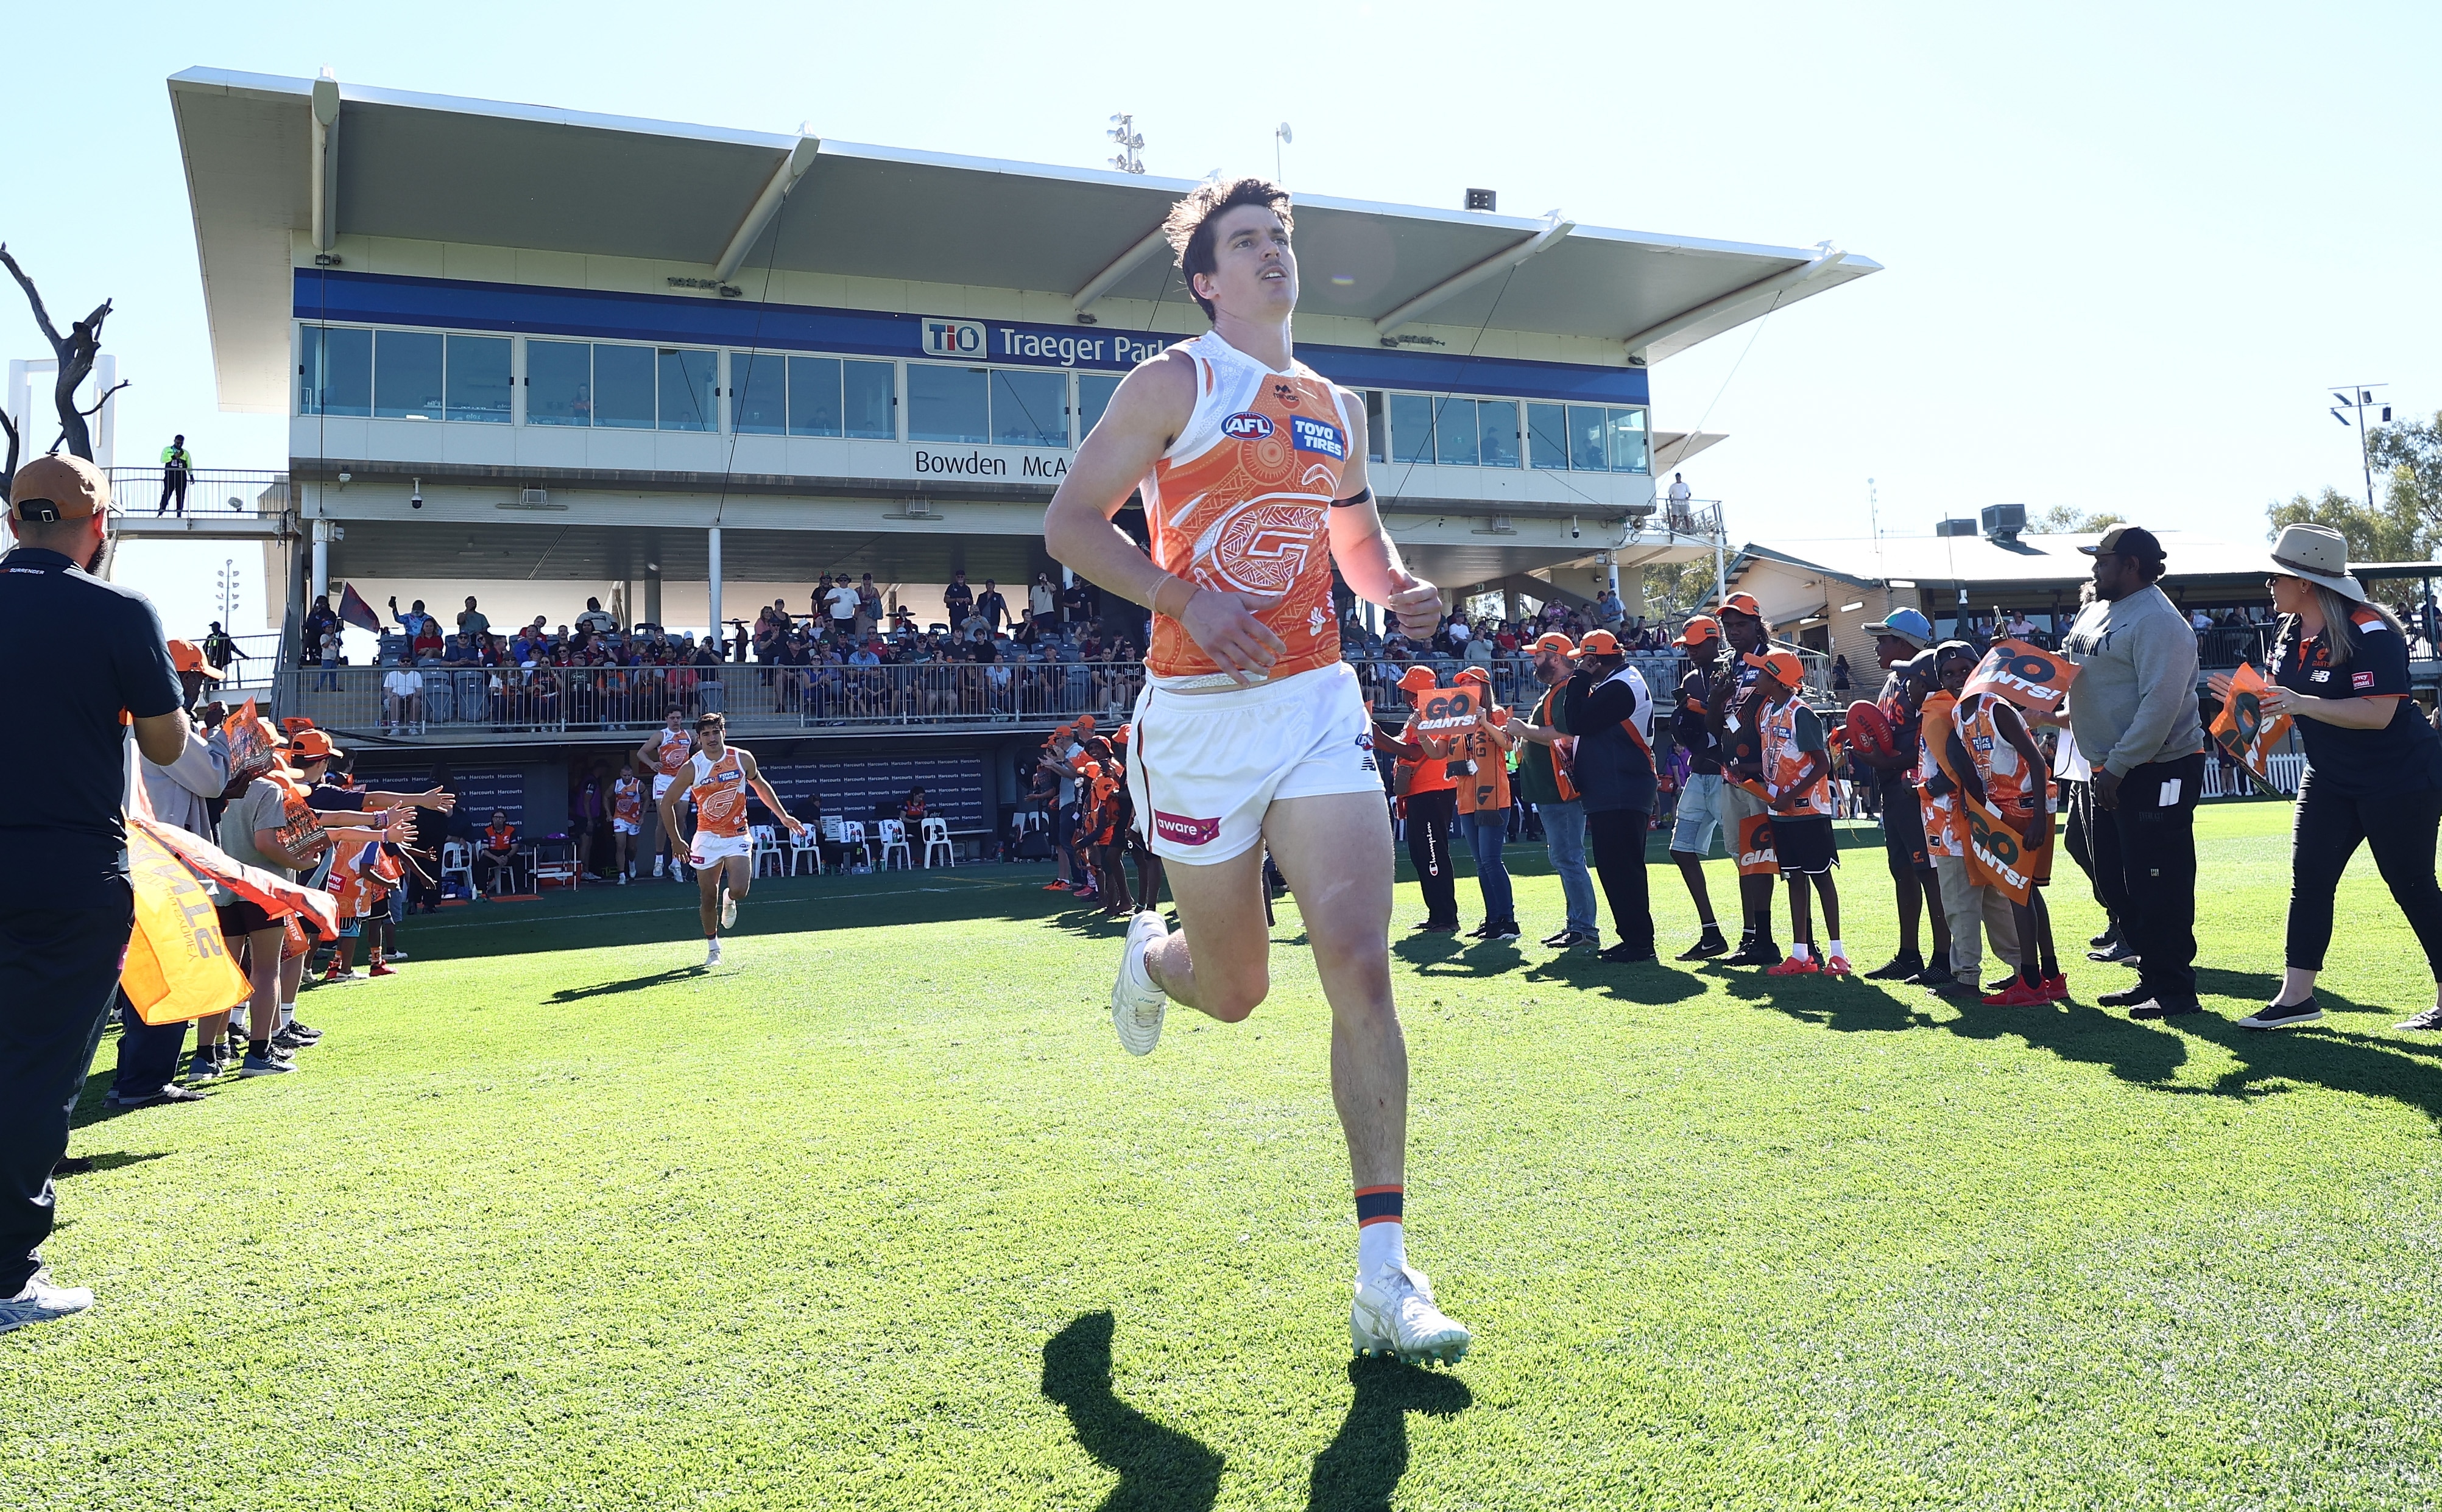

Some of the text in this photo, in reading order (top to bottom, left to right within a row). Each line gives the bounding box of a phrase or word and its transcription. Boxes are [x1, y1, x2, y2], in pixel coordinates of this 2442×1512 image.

[1000, 328, 1159, 366] Traeger Par
[1226, 418, 1271, 434] AFL
[1295, 420, 1334, 440] TOYO
[1304, 435, 1341, 457] TIRES
[915, 450, 1072, 477] Bowden McA
[1426, 694, 1469, 720] GO
[1417, 714, 1477, 730] GIANTS!
[1158, 818, 1198, 835] aware
[1967, 811, 2019, 866] GO
[1426, 821, 1439, 876] Champion
[1971, 835, 2028, 890] ANTS!
